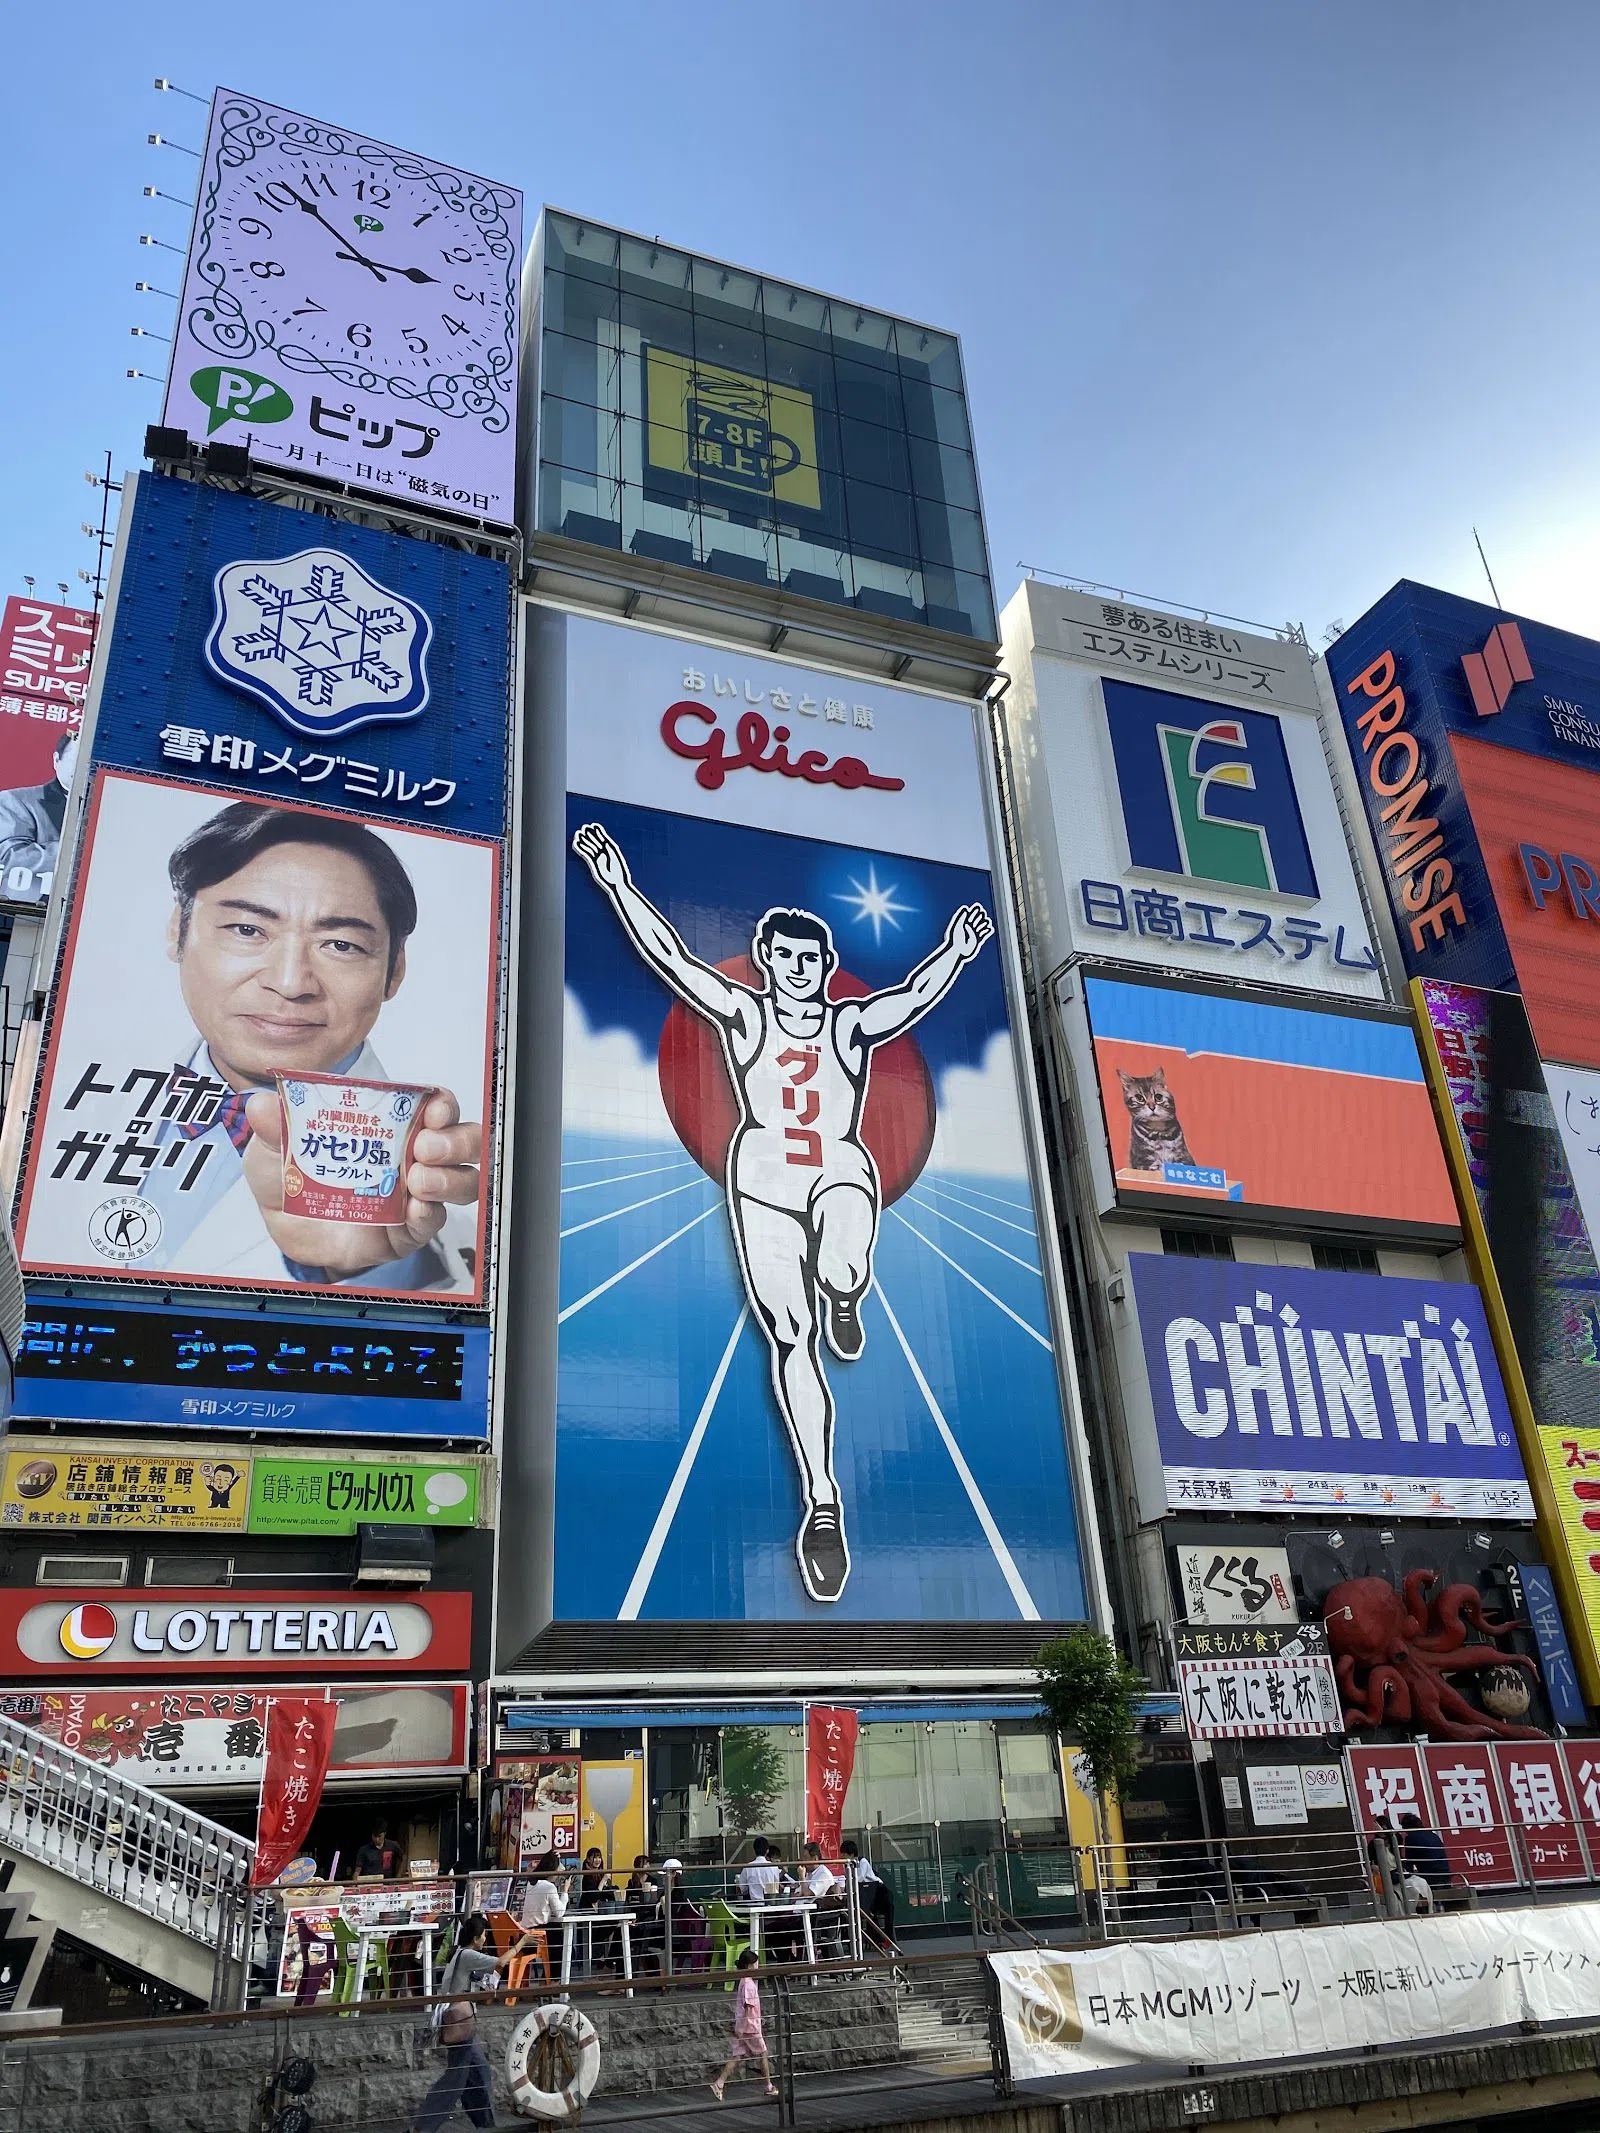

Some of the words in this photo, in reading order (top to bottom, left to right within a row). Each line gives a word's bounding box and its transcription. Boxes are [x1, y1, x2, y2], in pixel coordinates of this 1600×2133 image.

[253, 180, 301, 213] 10
[301, 173, 340, 198] 11
[351, 178, 392, 211] 12
[238, 217, 273, 240] 9
[412, 211, 434, 229] 1
[439, 246, 473, 266] 2
[249, 260, 286, 279] 8
[292, 296, 329, 317] 7
[453, 283, 485, 307] 3
[346, 322, 373, 349] 6
[440, 313, 471, 339] 4
[402, 327, 429, 354] 5
[310, 396, 441, 458] ピップ
[1101, 604, 1242, 655] 夢ある住まい
[1082, 631, 1274, 694] エステムシリーズ
[681, 666, 876, 731] おいしさと健康
[1543, 695, 1586, 719] SMBC
[660, 700, 906, 791] Glico
[159, 723, 457, 808] 雪印メグミルク
[1348, 650, 1467, 953] PROMISE
[1081, 878, 1378, 971] 日商エステム
[63, 1062, 229, 1126] トクホ
[339, 1088, 360, 1107] 恵
[775, 1044, 825, 1169] グリコ
[125, 1119, 151, 1135] の
[306, 1119, 394, 1140] 減らすのを助ける
[317, 1109, 382, 1126] 内臓脂肪を
[49, 1129, 216, 1191] ガセリ
[316, 1164, 373, 1181] ヨーグルト
[1163, 1290, 1498, 1448] CHINTAI
[180, 1397, 297, 1420] 雪印メグミルク
[70, 1456, 101, 1464] KANSAI
[103, 1457, 133, 1466] INVEST
[135, 1458, 195, 1467] CORPORATION
[65, 1482, 193, 1494] 居抜き店舗総合プロデュース
[67, 1464, 195, 1486] 店舗情報館
[326, 1470, 415, 1513] ピタットハウス
[1177, 1479, 1234, 1500] 天気予報
[28, 1512, 81, 1524] 株式会社
[87, 1512, 166, 1526] 関西インベスト
[1186, 1553, 1207, 1614] 道頓堀
[1203, 1555, 1273, 1613] くくる
[1506, 1564, 1525, 1609] 2F
[133, 1608, 398, 1653] LOTTERIA
[1177, 1630, 1284, 1655] 大阪もんを食す
[1307, 1642, 1324, 1655] 2F
[160, 1693, 256, 1718] たこやき
[1192, 1670, 1316, 1724] 大阪に乾杯
[280, 1715, 316, 1834] たこ焼き
[821, 1719, 843, 1815] たこ焼き
[554, 1827, 573, 1848] 8F
[1463, 1849, 1495, 1867] Visa
[1532, 1843, 1569, 1863] カード
[1088, 1977, 1301, 2027] 日本MGMリゾーツ
